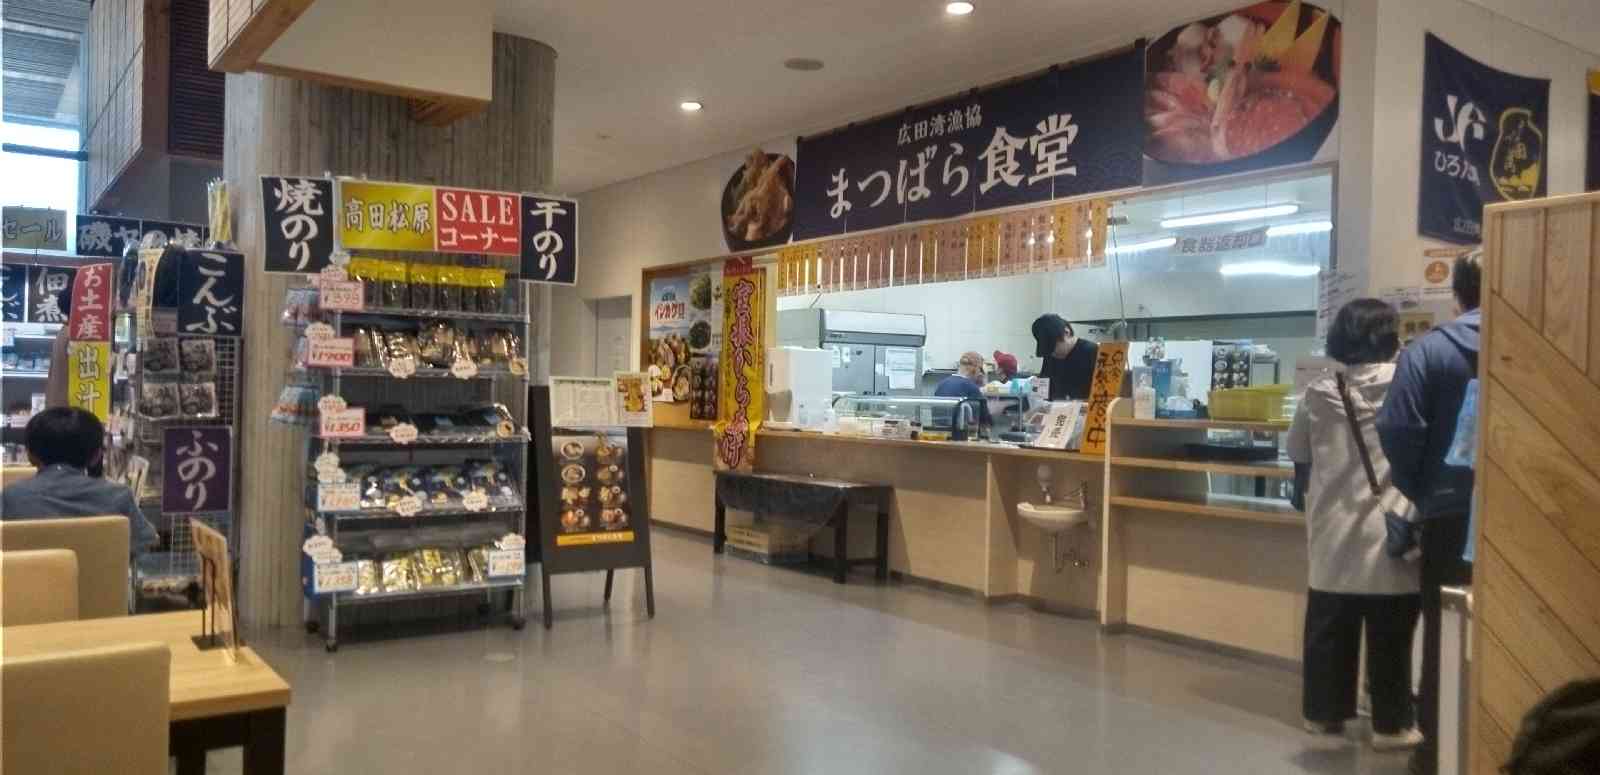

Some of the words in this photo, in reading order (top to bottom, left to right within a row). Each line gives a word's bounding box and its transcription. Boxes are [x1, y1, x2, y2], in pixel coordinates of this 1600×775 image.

[897, 104, 983, 145] 広田湾漁協
[826, 113, 1080, 219] まつばら食堂
[2, 217, 63, 243] セール
[274, 177, 325, 271] 焼のり
[345, 197, 433, 235] 高田松原
[439, 226, 518, 251] コーナー
[441, 191, 515, 227] SALE
[530, 200, 568, 281] 干のり
[76, 265, 105, 339] お土産
[186, 253, 237, 334] こんぶ
[76, 344, 101, 410] 出汁
[176, 429, 220, 512] ふのり
